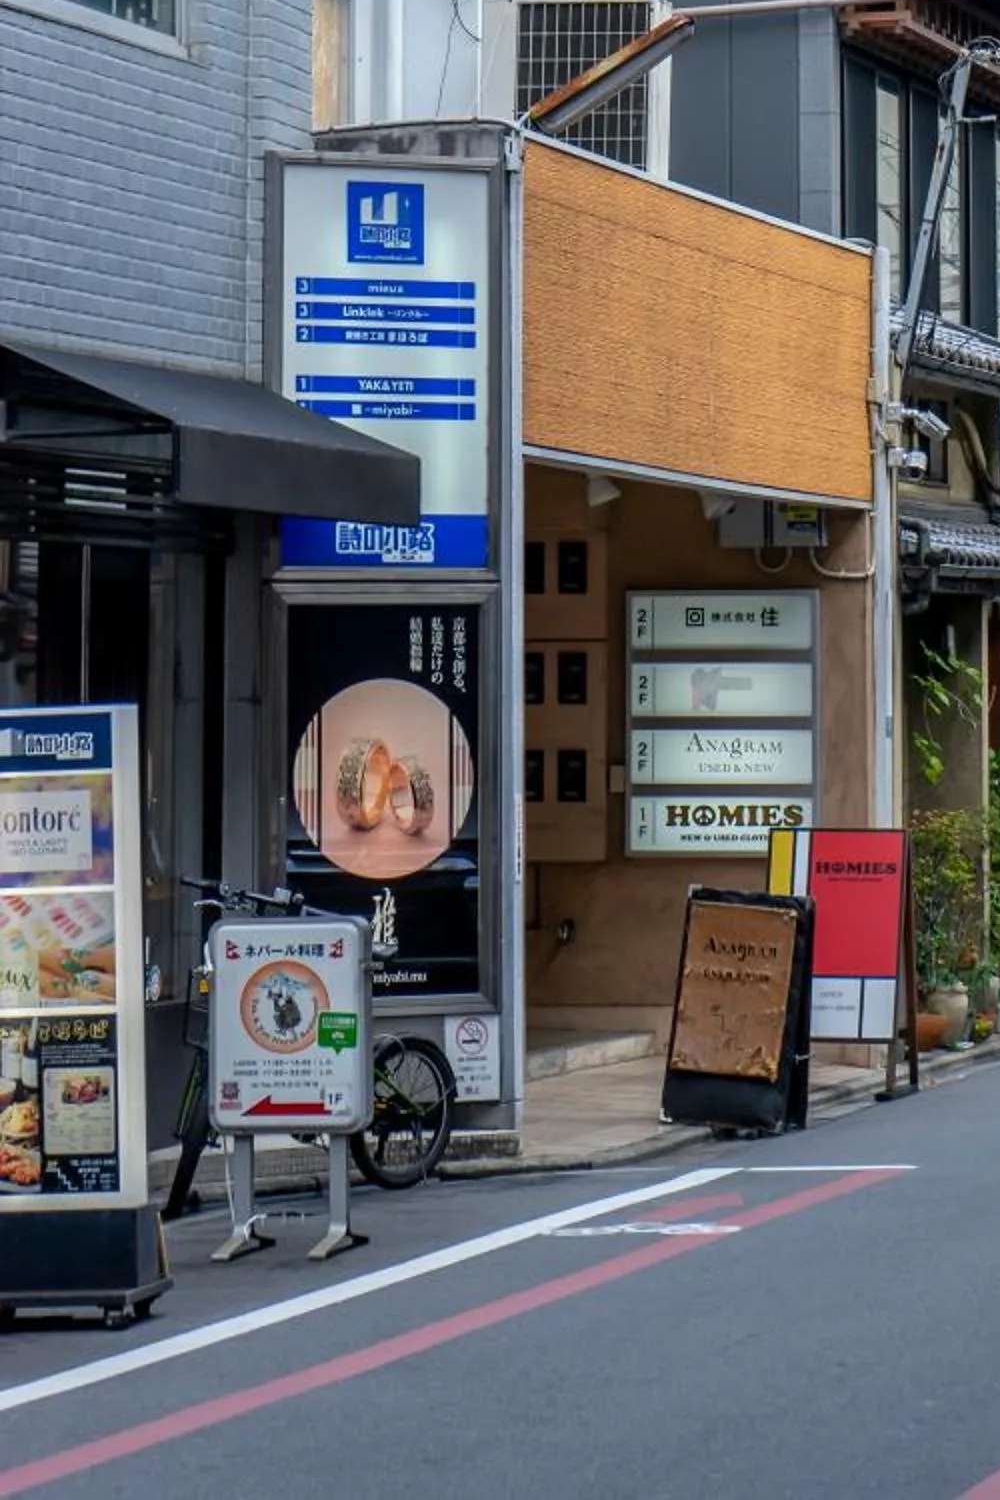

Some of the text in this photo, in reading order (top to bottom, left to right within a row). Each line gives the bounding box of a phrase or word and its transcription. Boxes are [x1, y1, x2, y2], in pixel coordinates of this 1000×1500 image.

[299, 281, 309, 291] 3
[299, 306, 309, 317] 3
[299, 328, 309, 340] 2
[300, 378, 307, 389] 1
[665, 805, 804, 827] HOMIES
[740, 833, 769, 841] CLOT
[816, 861, 897, 874] HOMIES
